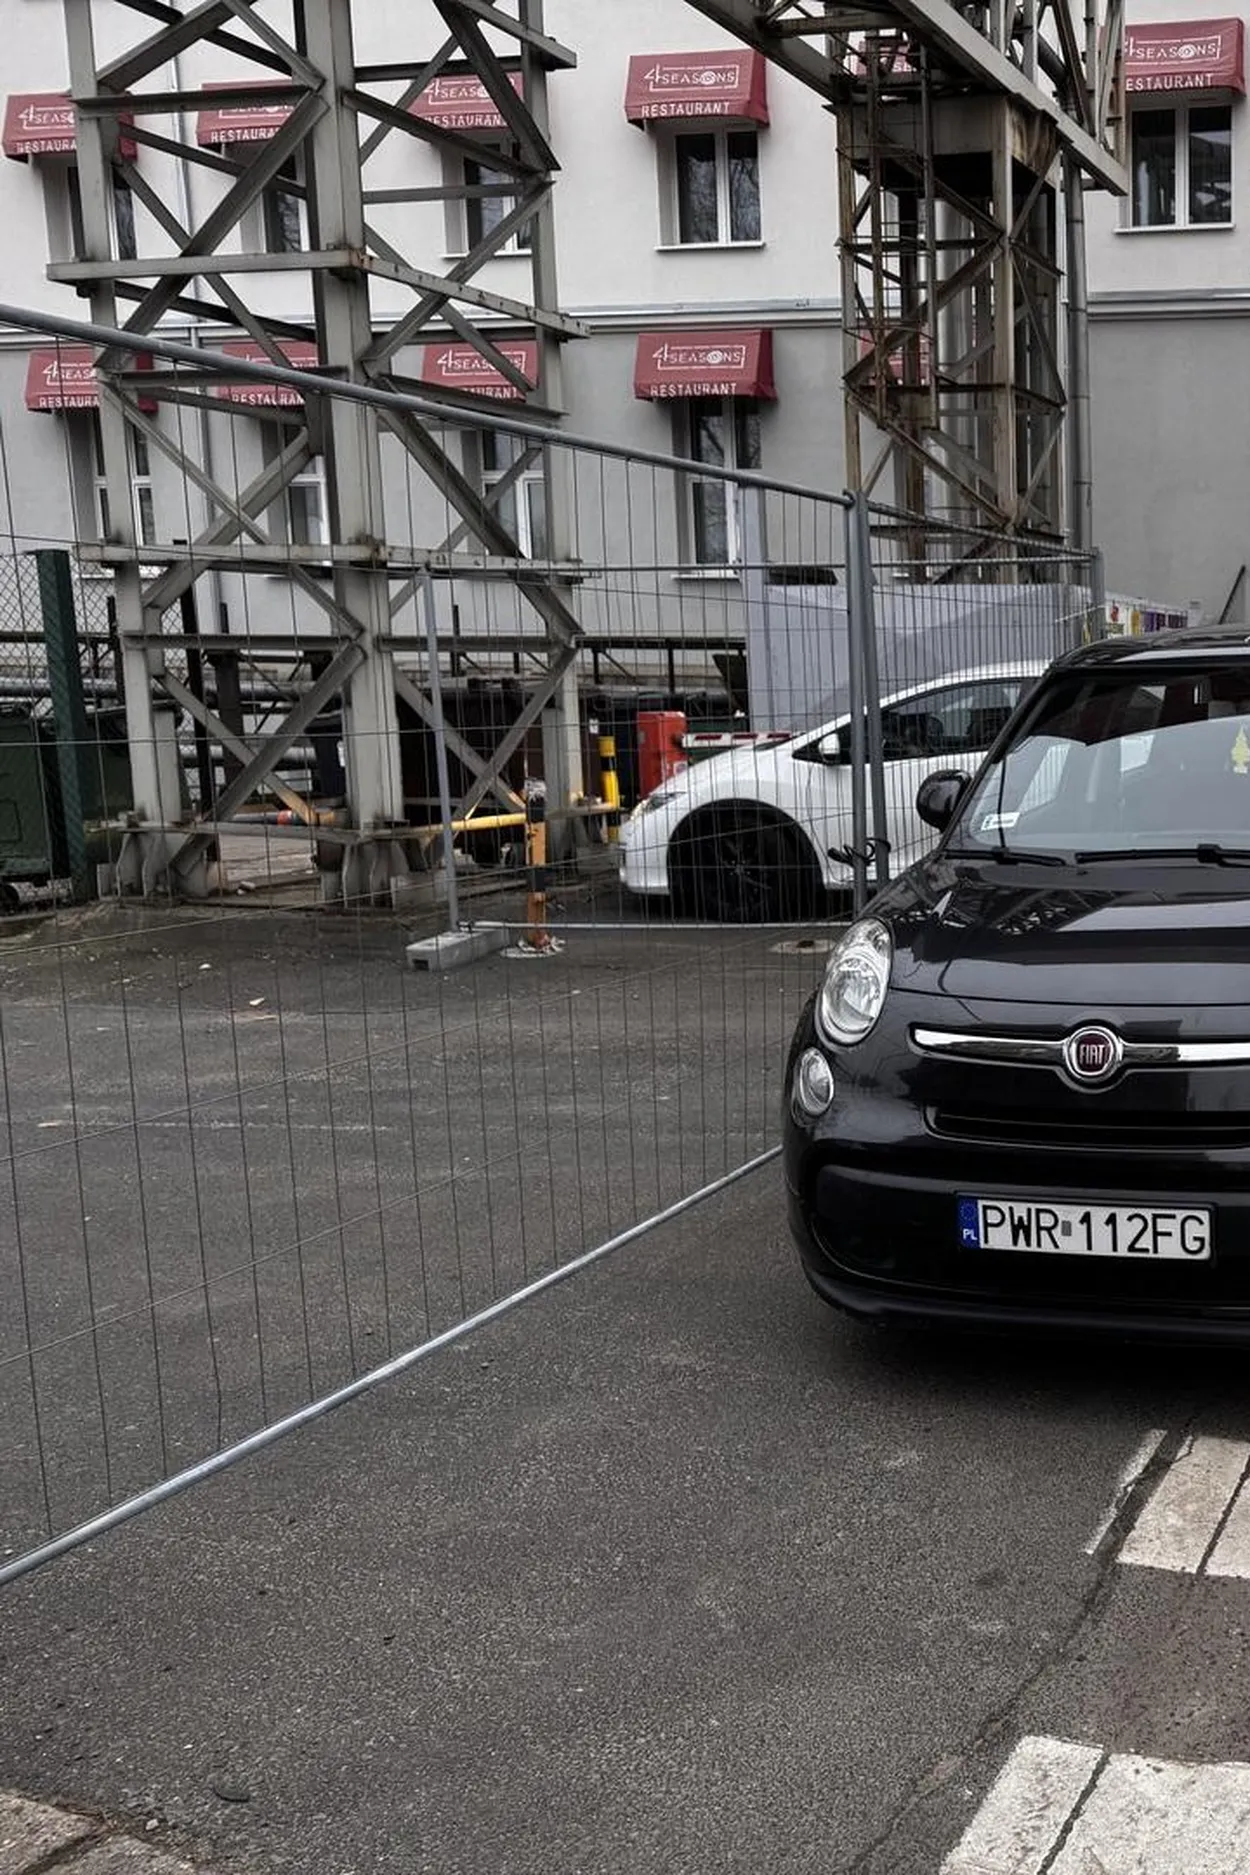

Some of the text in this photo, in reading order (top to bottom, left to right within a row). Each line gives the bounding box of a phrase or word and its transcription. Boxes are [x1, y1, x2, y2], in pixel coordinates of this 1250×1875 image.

[1126, 74, 1213, 91] ESTAURANT
[641, 101, 731, 117] RESTAURANT
[210, 127, 280, 143] RESTAURA
[15, 139, 77, 154] RESTAURA
[650, 383, 737, 398] RESTAURANT
[39, 396, 100, 408] RESTAURA
[1079, 1043, 1106, 1065] FIAT
[962, 1228, 978, 1241] PL
